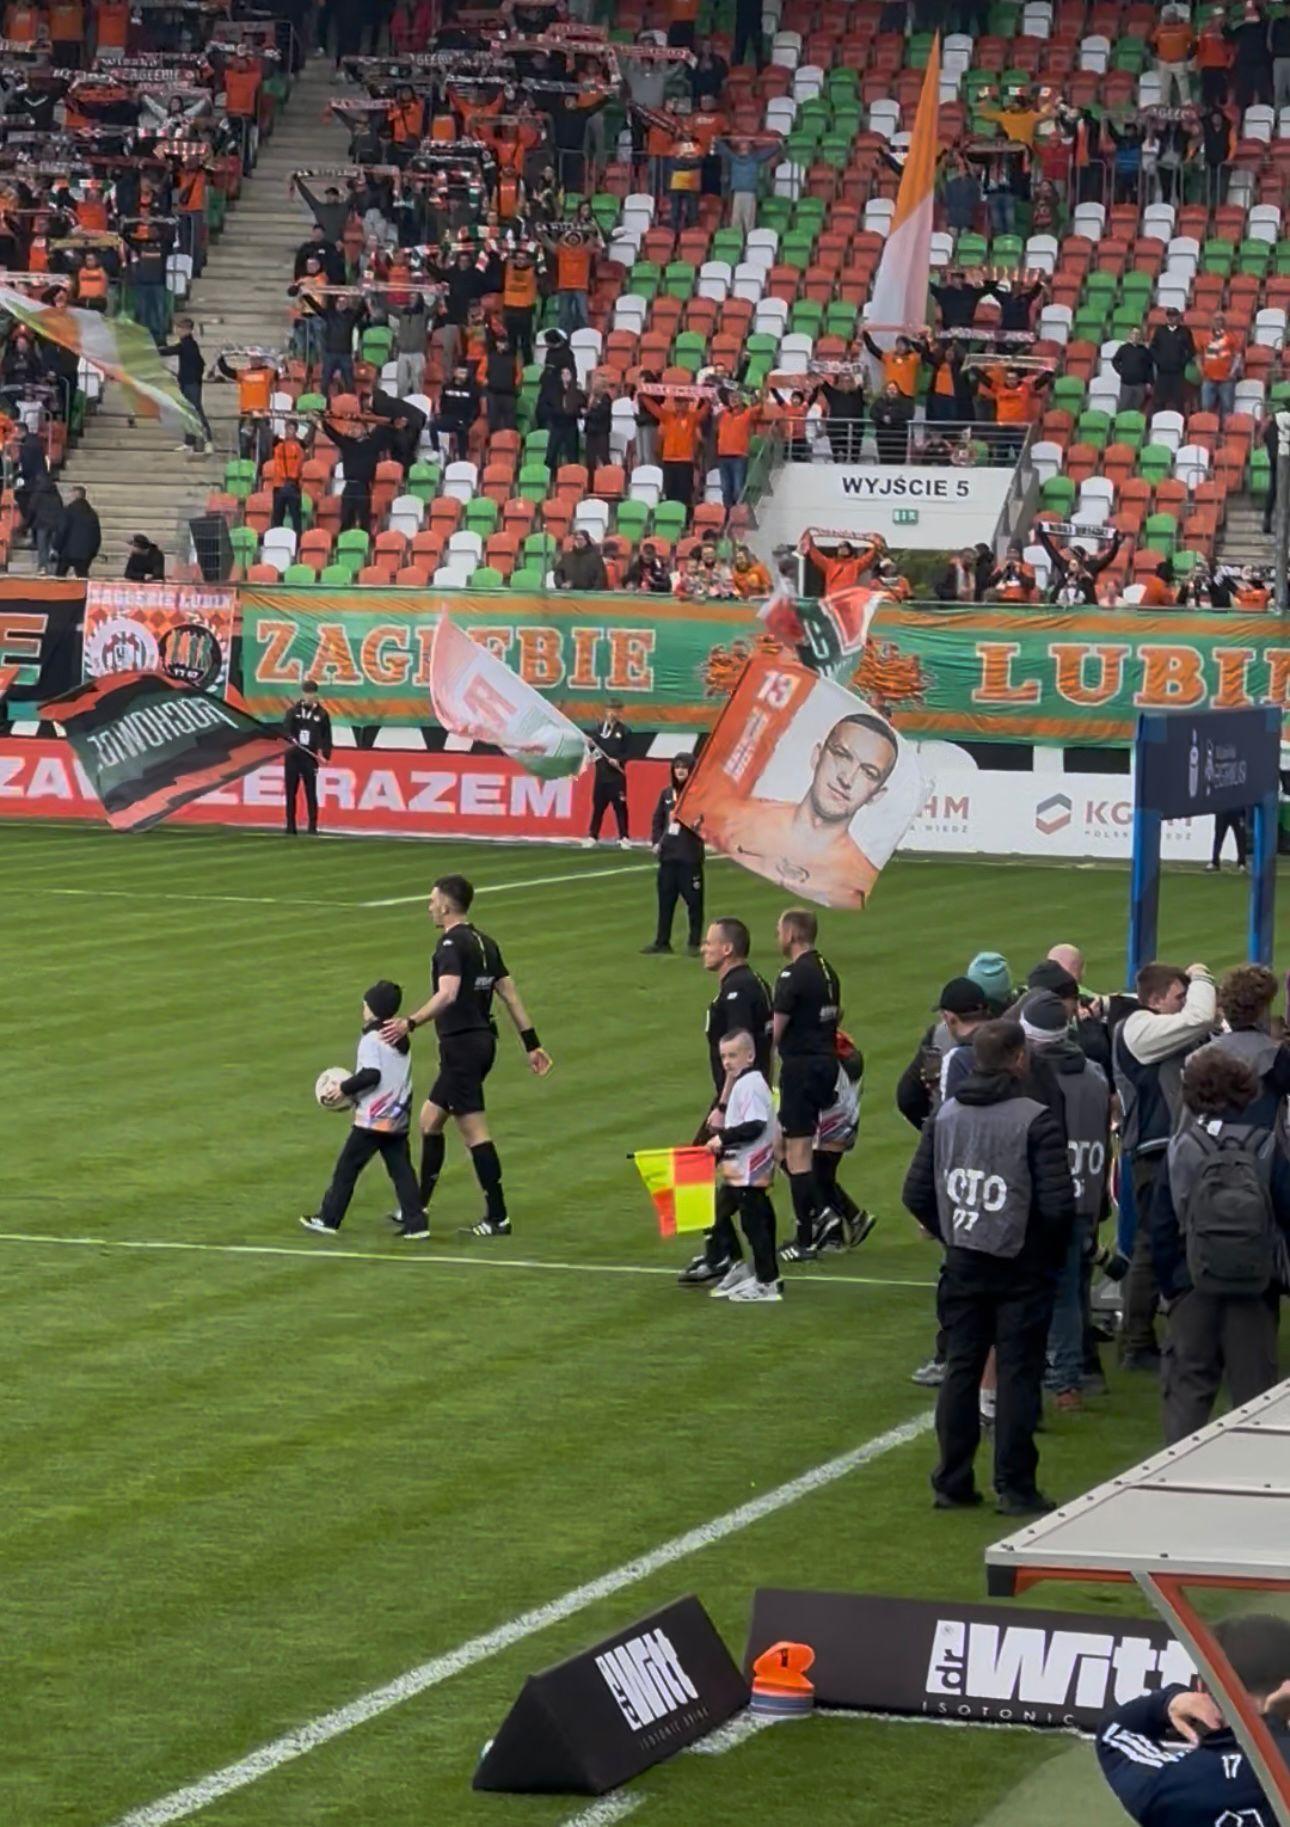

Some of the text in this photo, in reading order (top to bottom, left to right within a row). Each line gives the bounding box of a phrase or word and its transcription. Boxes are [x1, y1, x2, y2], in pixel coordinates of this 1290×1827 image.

[842, 474, 970, 497] WYJŚCIE 5
[757, 670, 801, 709] 13
[316, 767, 573, 819] RAZEM
[922, 1701, 1075, 1724] ISOTONIC
[1222, 1754, 1242, 1779] 17
